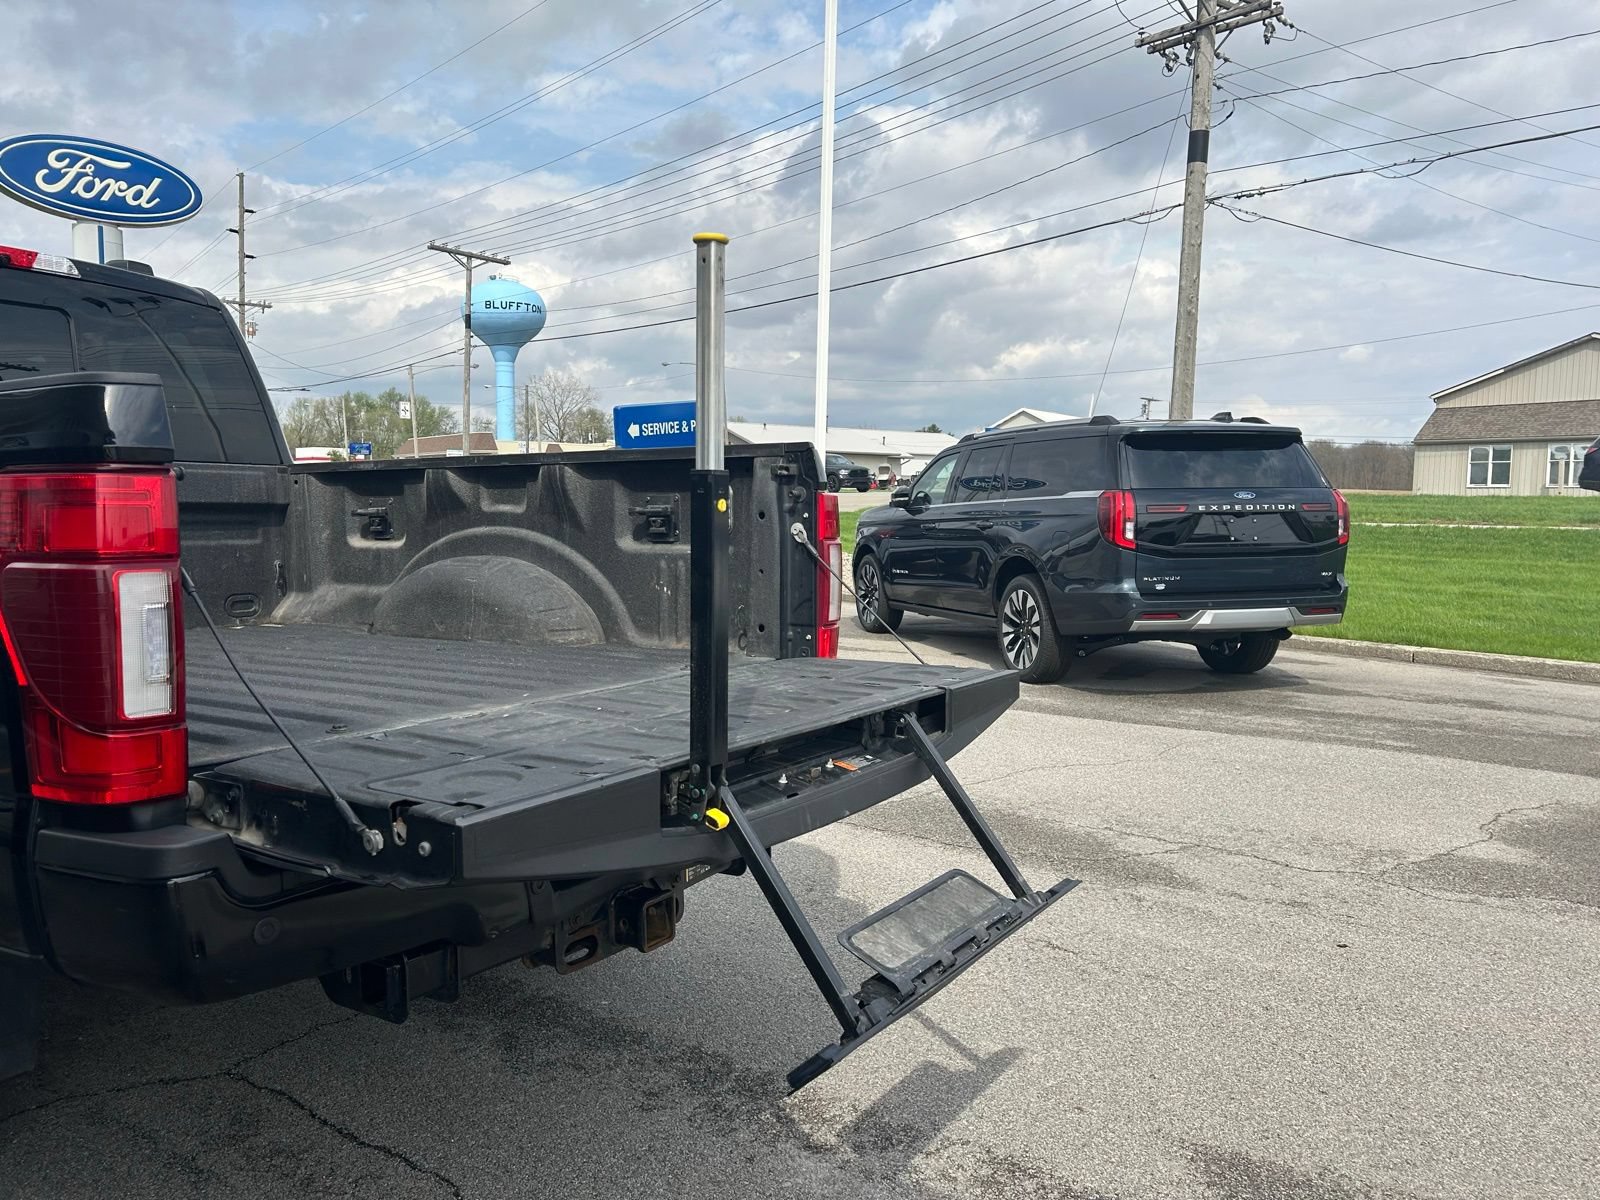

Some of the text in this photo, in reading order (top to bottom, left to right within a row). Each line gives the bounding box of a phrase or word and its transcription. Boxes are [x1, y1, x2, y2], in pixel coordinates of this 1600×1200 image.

[35, 148, 163, 208] Ford
[484, 300, 542, 314] BLUFFTON
[641, 421, 680, 436] SERVICE
[682, 420, 688, 433] &
